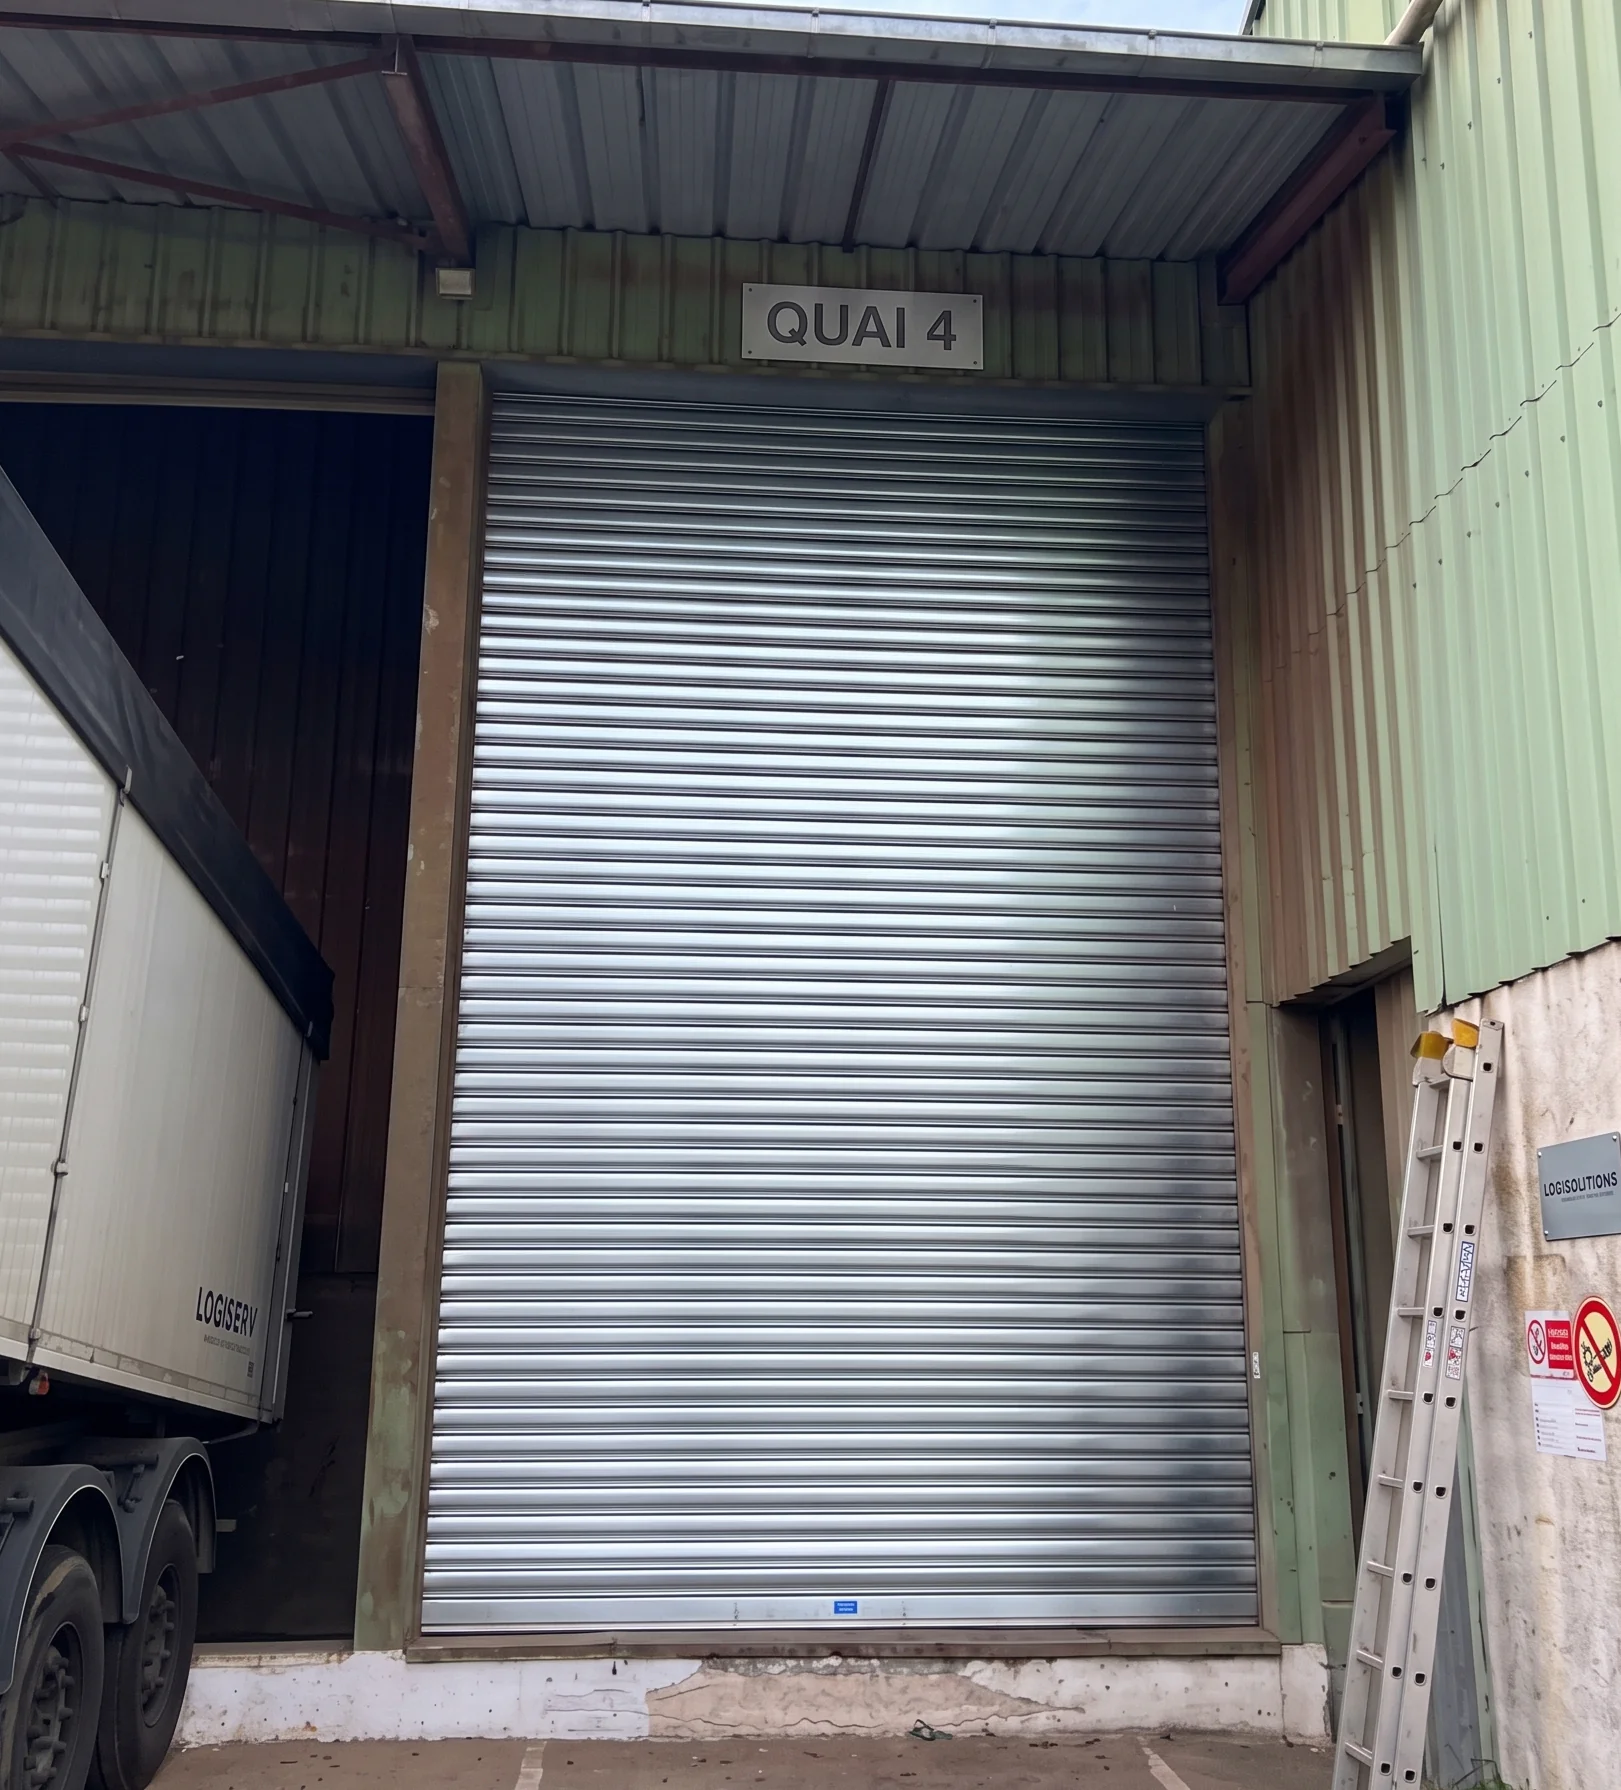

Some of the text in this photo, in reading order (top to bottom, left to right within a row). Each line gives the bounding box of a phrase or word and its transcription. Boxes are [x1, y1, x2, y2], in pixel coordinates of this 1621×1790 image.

[767, 301, 957, 350] QUAI 4
[196, 1286, 258, 1338] LOGISERV
